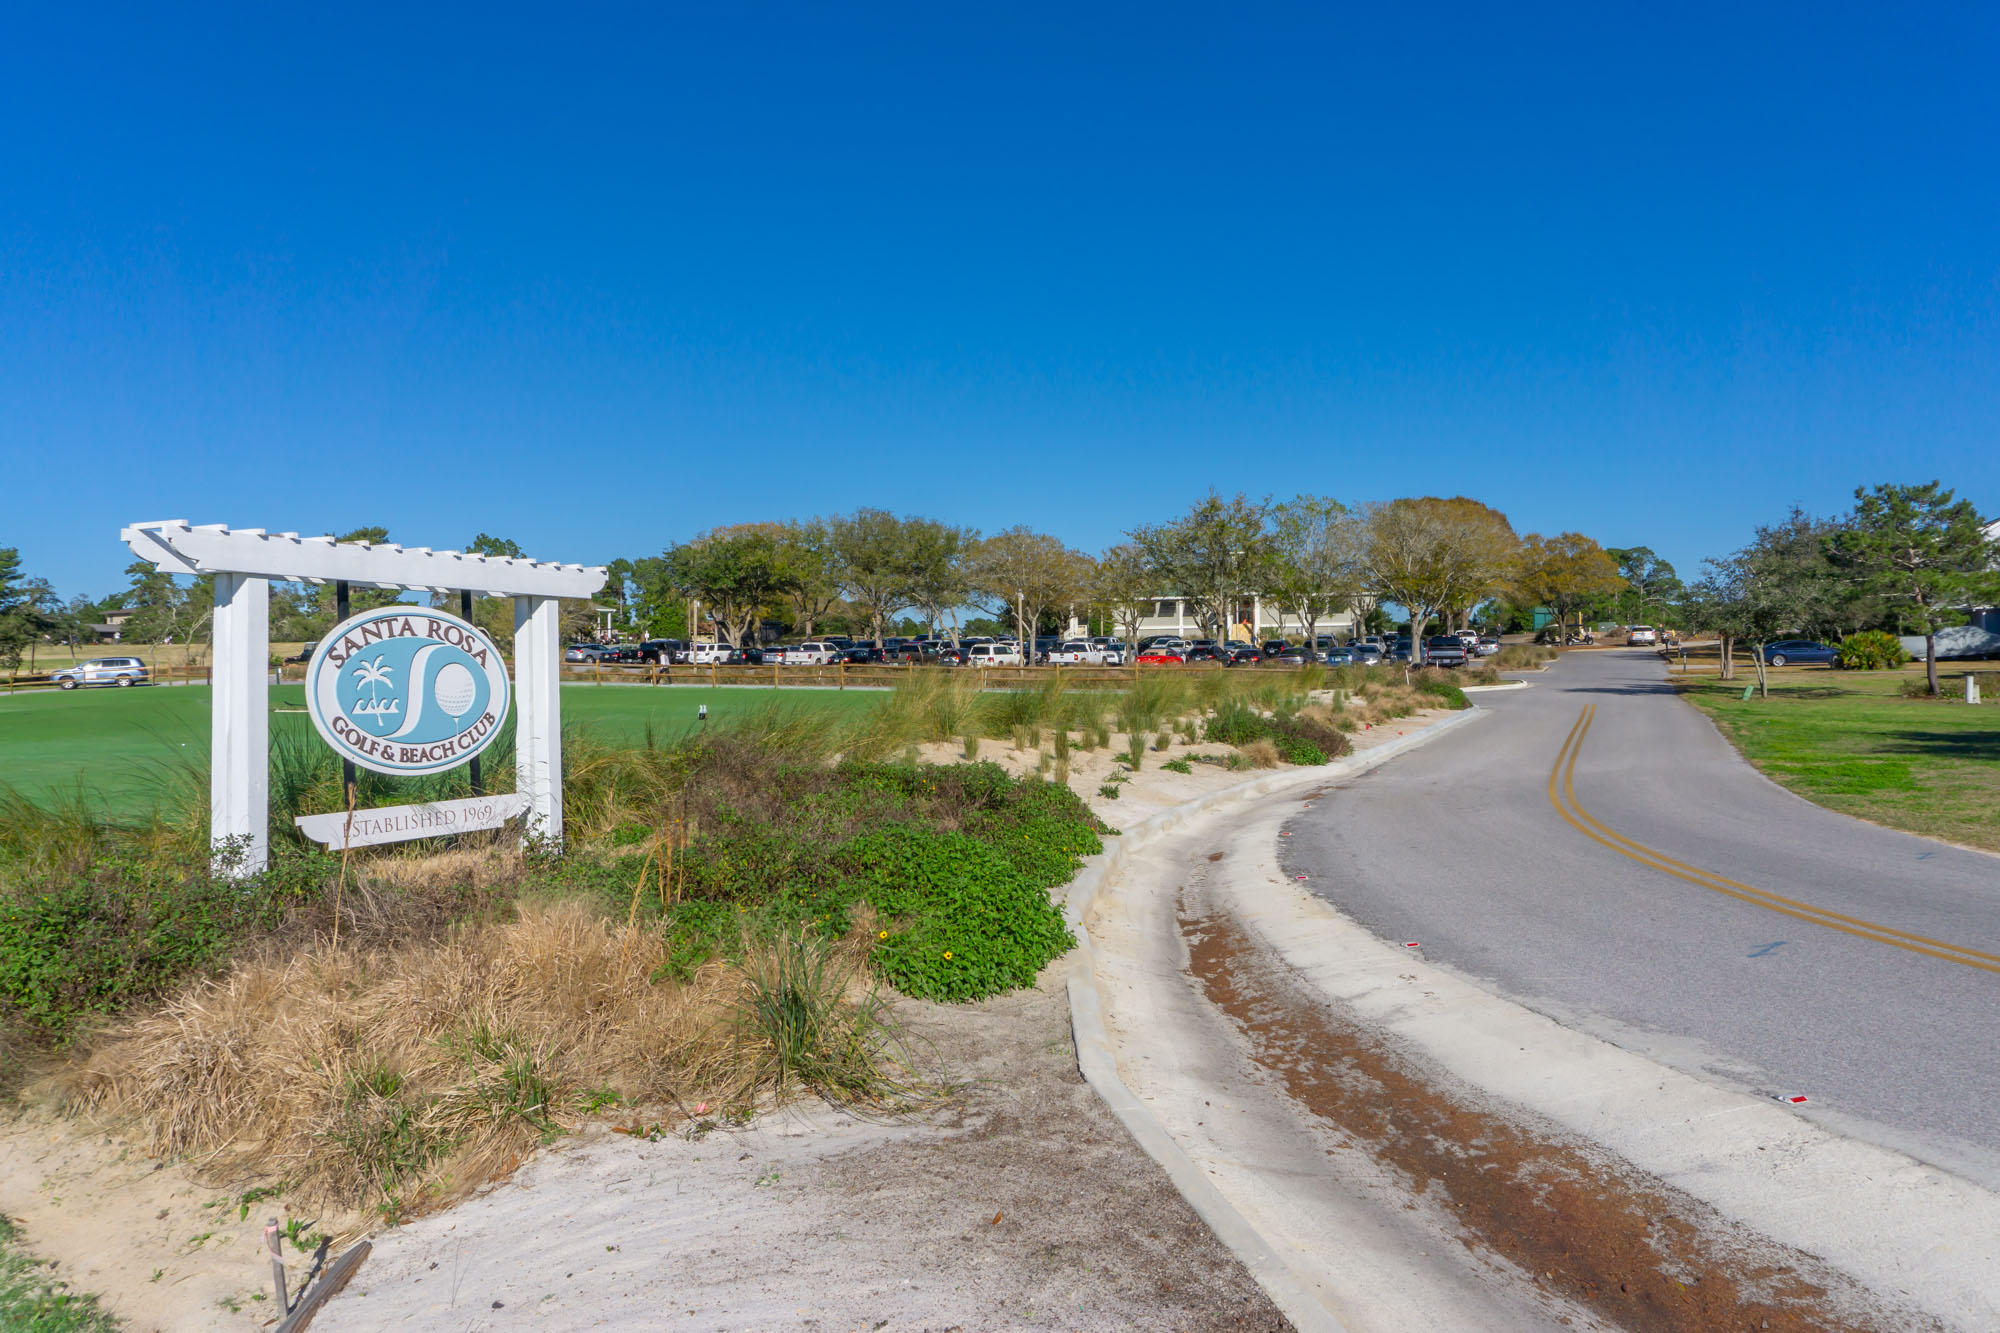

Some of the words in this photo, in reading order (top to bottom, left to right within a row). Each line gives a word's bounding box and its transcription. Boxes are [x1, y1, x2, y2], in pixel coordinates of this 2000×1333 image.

[328, 616, 417, 669] SANTA
[427, 618, 489, 669] ROSA
[332, 716, 379, 755] GOLF
[380, 744, 395, 762] &
[399, 741, 457, 763] BEACH
[457, 711, 496, 750] CLUB
[463, 805, 493, 822] 1969
